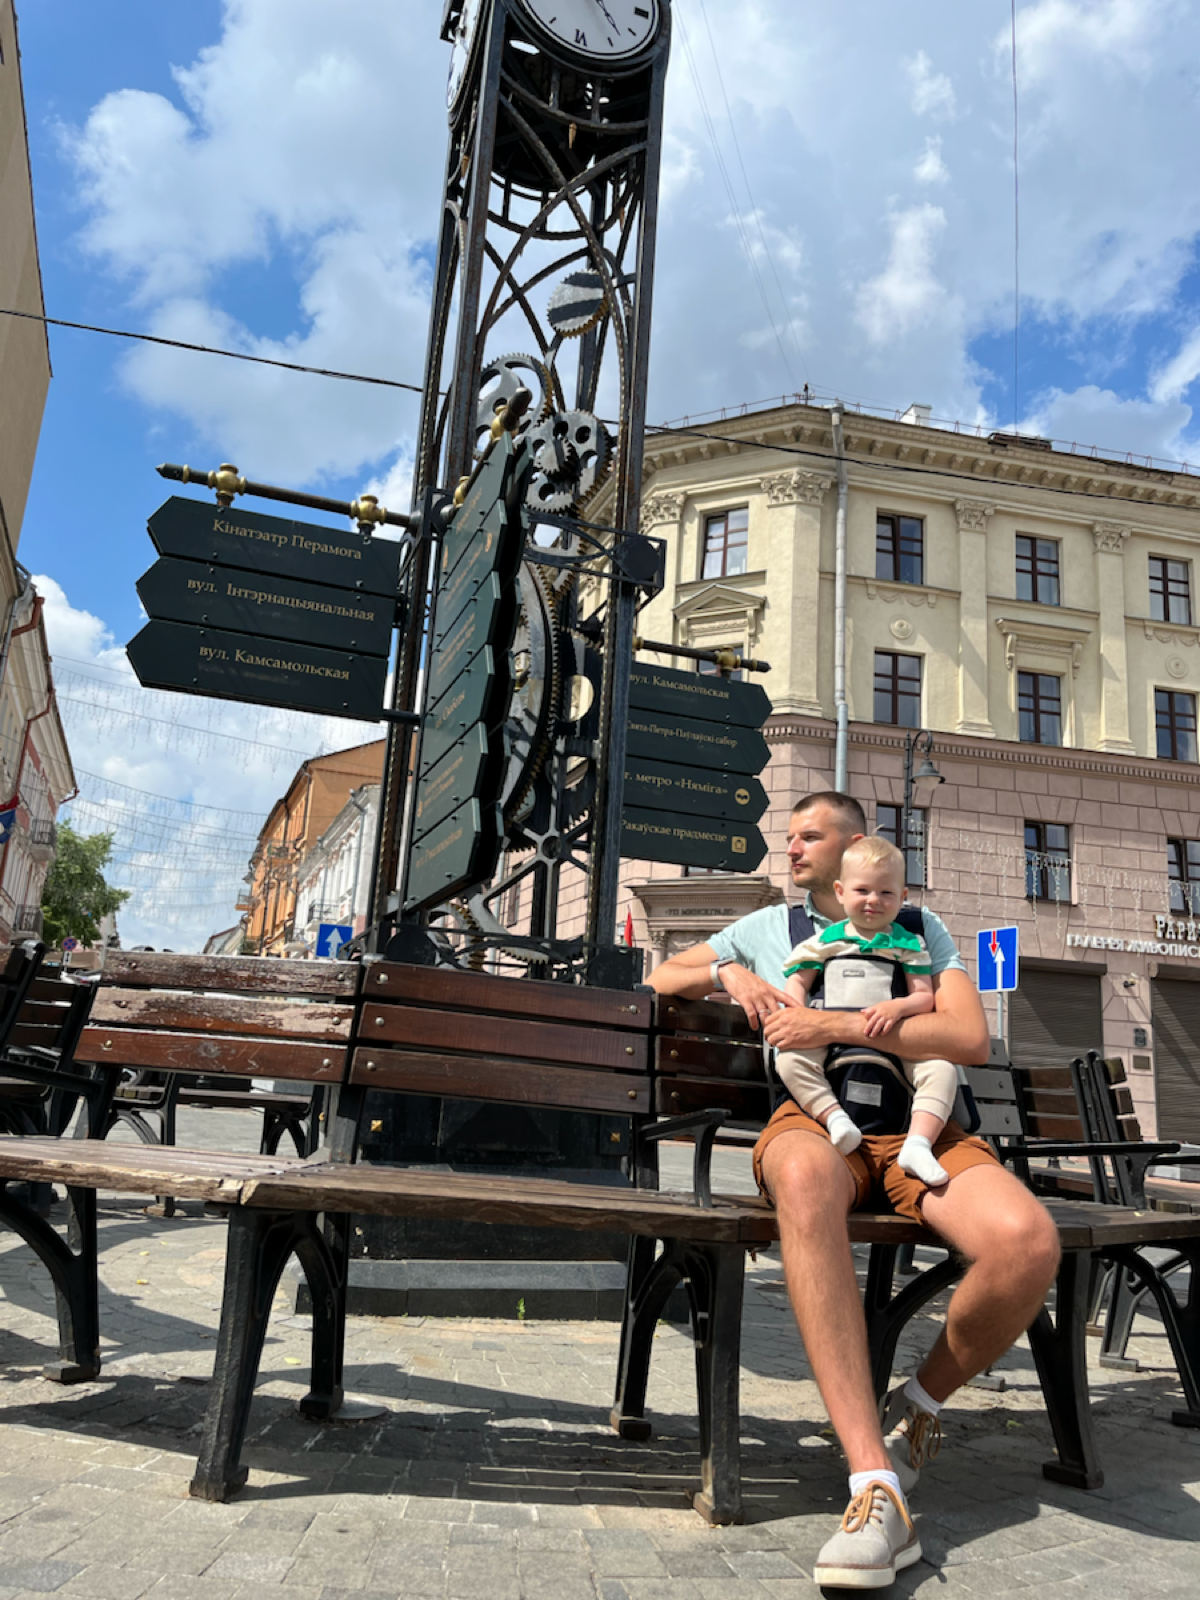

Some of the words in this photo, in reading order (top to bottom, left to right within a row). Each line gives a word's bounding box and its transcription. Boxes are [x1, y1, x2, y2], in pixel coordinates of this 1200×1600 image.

[212, 518, 288, 548] Кінатэатр
[291, 533, 362, 560] Перамога
[187, 578, 218, 594] вул.
[226, 582, 375, 622] Інтэрнацыянальная
[199, 644, 230, 661] вул.
[235, 648, 351, 681] Камсамольская
[652, 675, 730, 700] Камсамольская
[715, 735, 738, 748] сабор
[635, 773, 673, 788] метро
[1154, 914, 1200, 941] РАРИ
[1066, 933, 1125, 952] ГАЛЕРЕЯ
[1127, 939, 1200, 958] ЖИВОПИС
